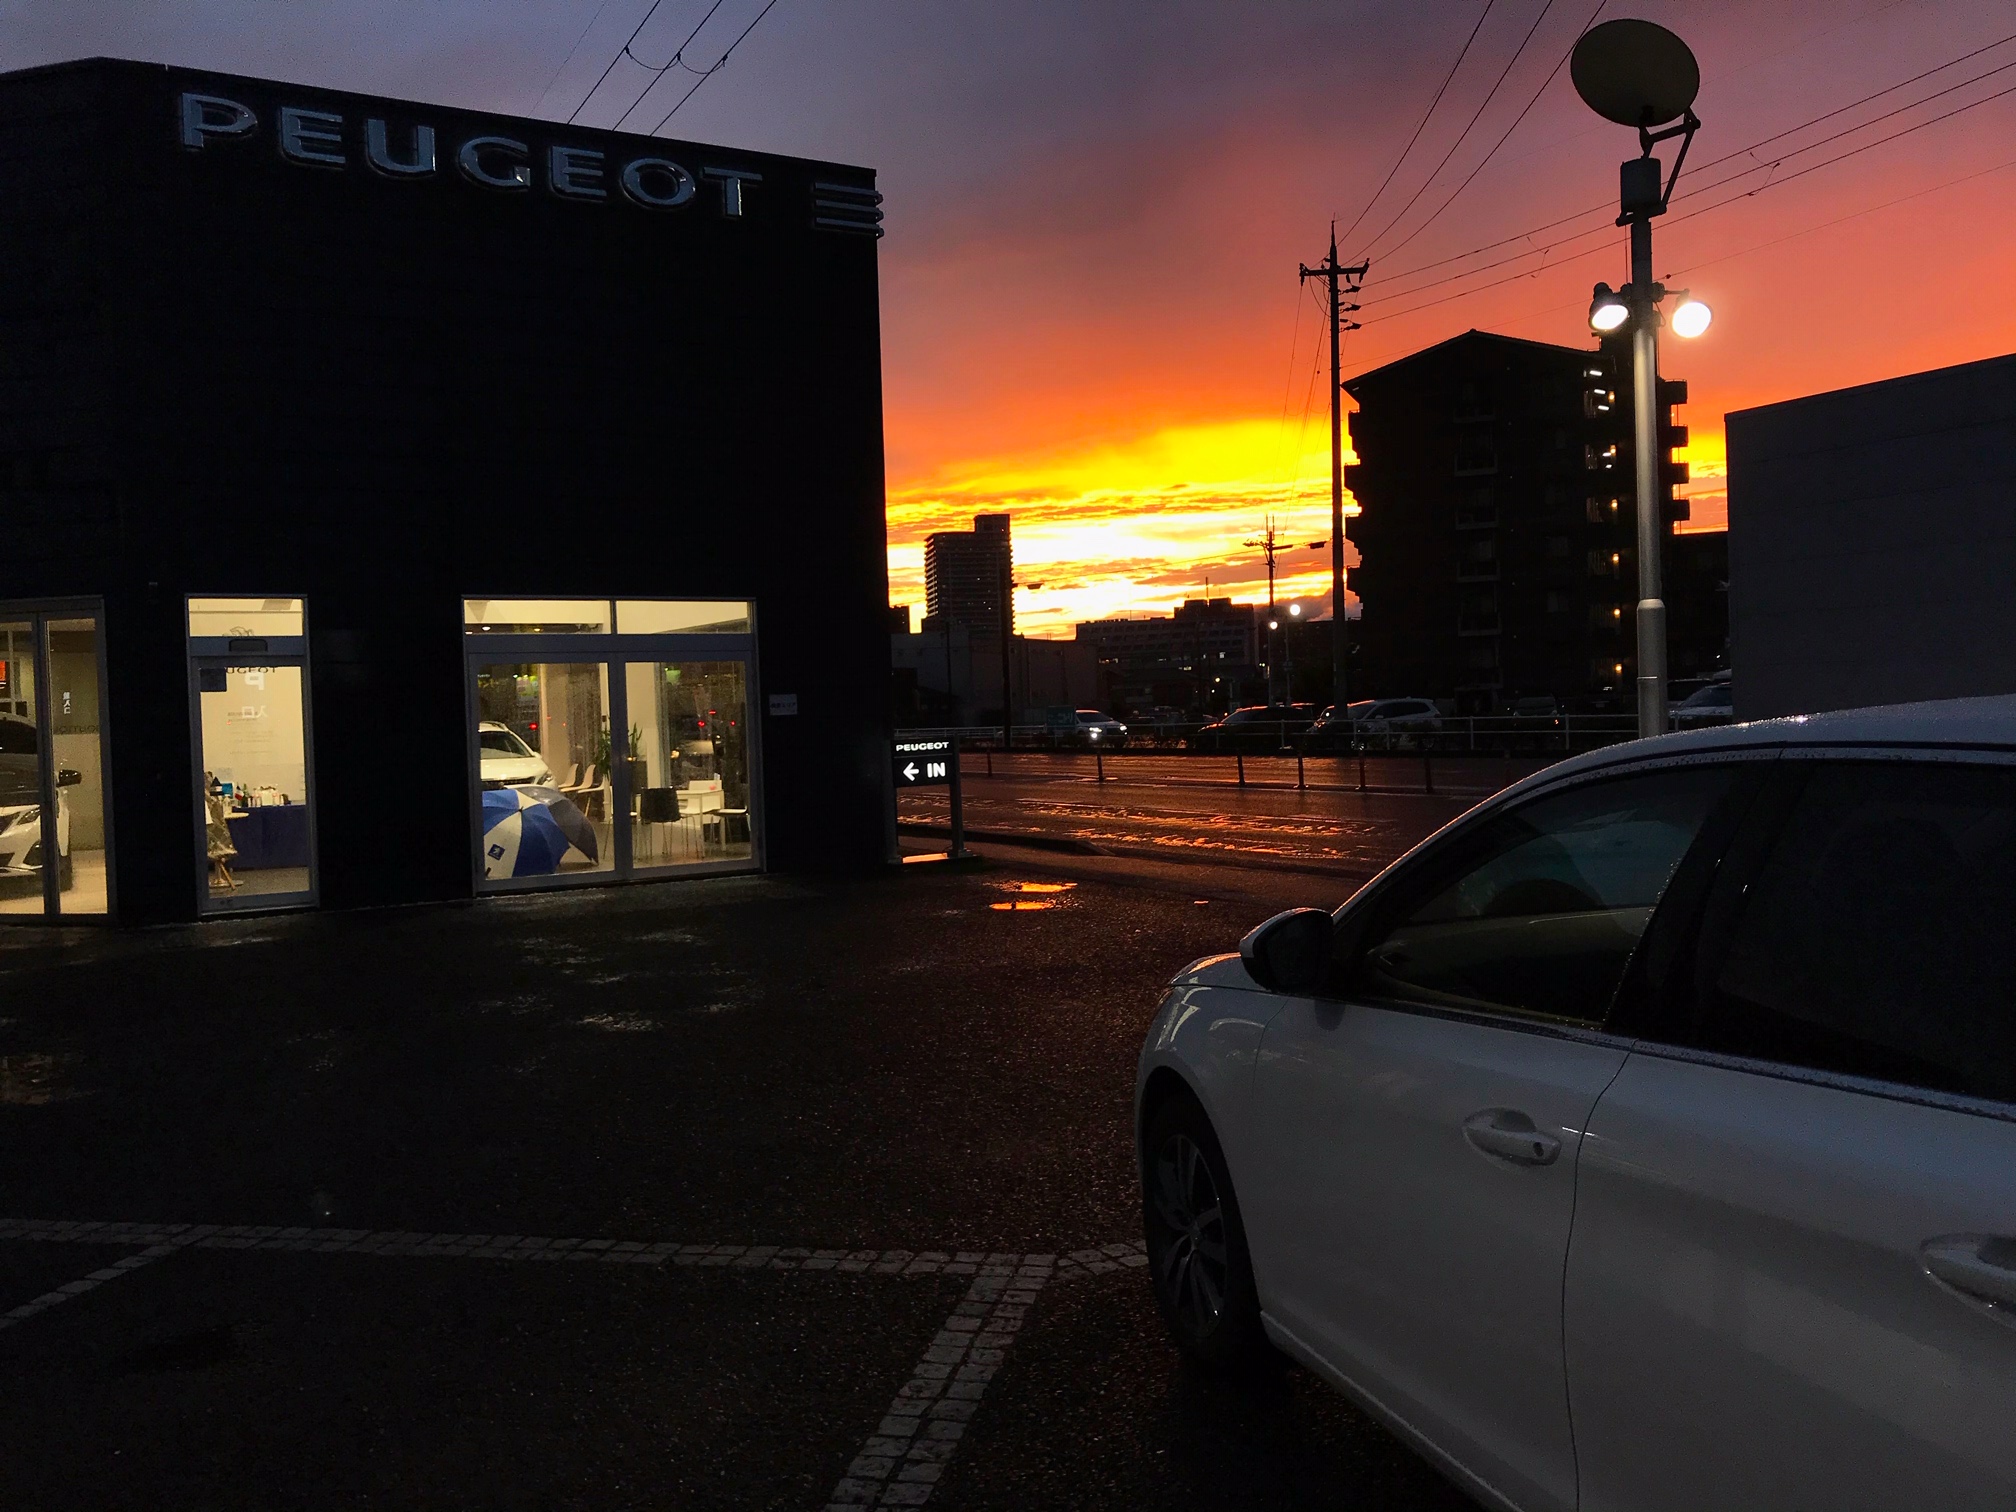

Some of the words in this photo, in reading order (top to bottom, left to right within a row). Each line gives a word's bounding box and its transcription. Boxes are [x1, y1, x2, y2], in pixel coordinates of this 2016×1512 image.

[181, 92, 763, 216] PEUGEOT
[895, 741, 950, 752] PEUGEOT
[926, 762, 946, 779] IN
